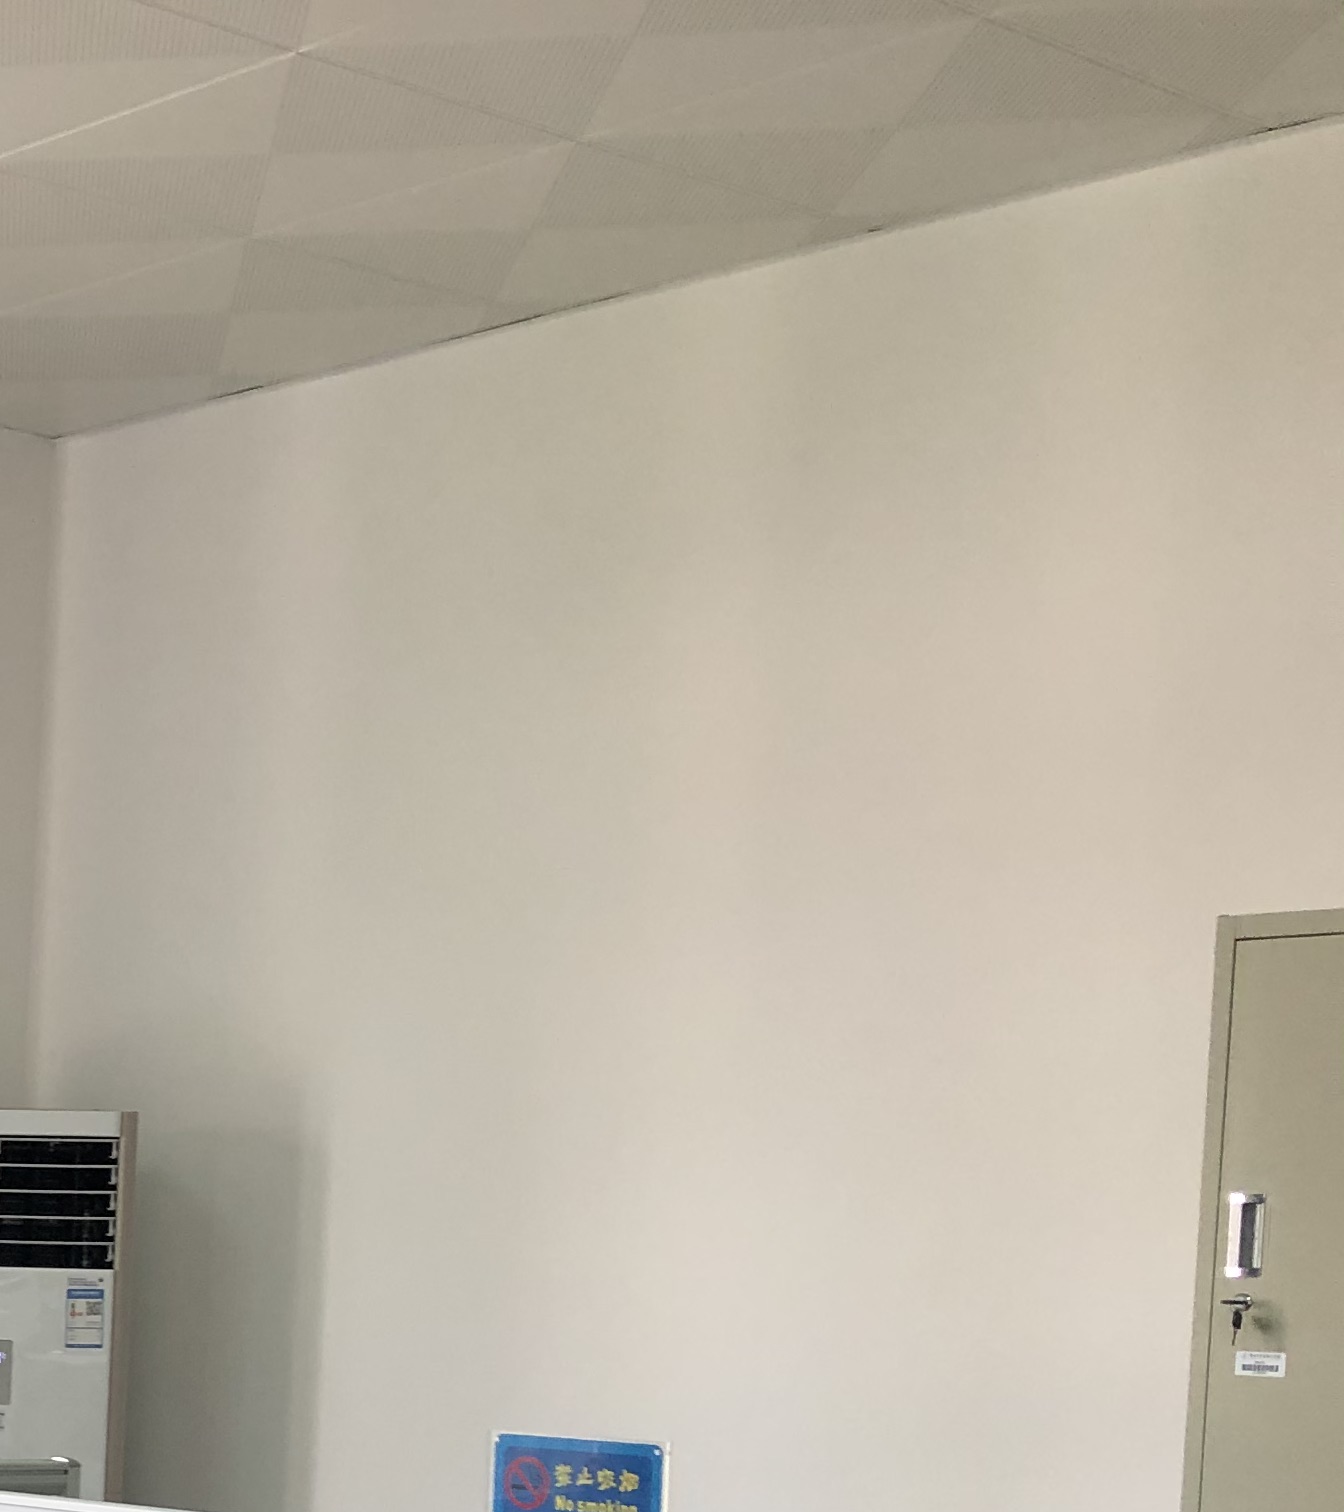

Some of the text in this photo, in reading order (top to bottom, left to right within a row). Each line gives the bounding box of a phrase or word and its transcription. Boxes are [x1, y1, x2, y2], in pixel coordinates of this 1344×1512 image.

[554, 1463, 640, 1493] 禁止吸烟
[554, 1494, 574, 1512] No
